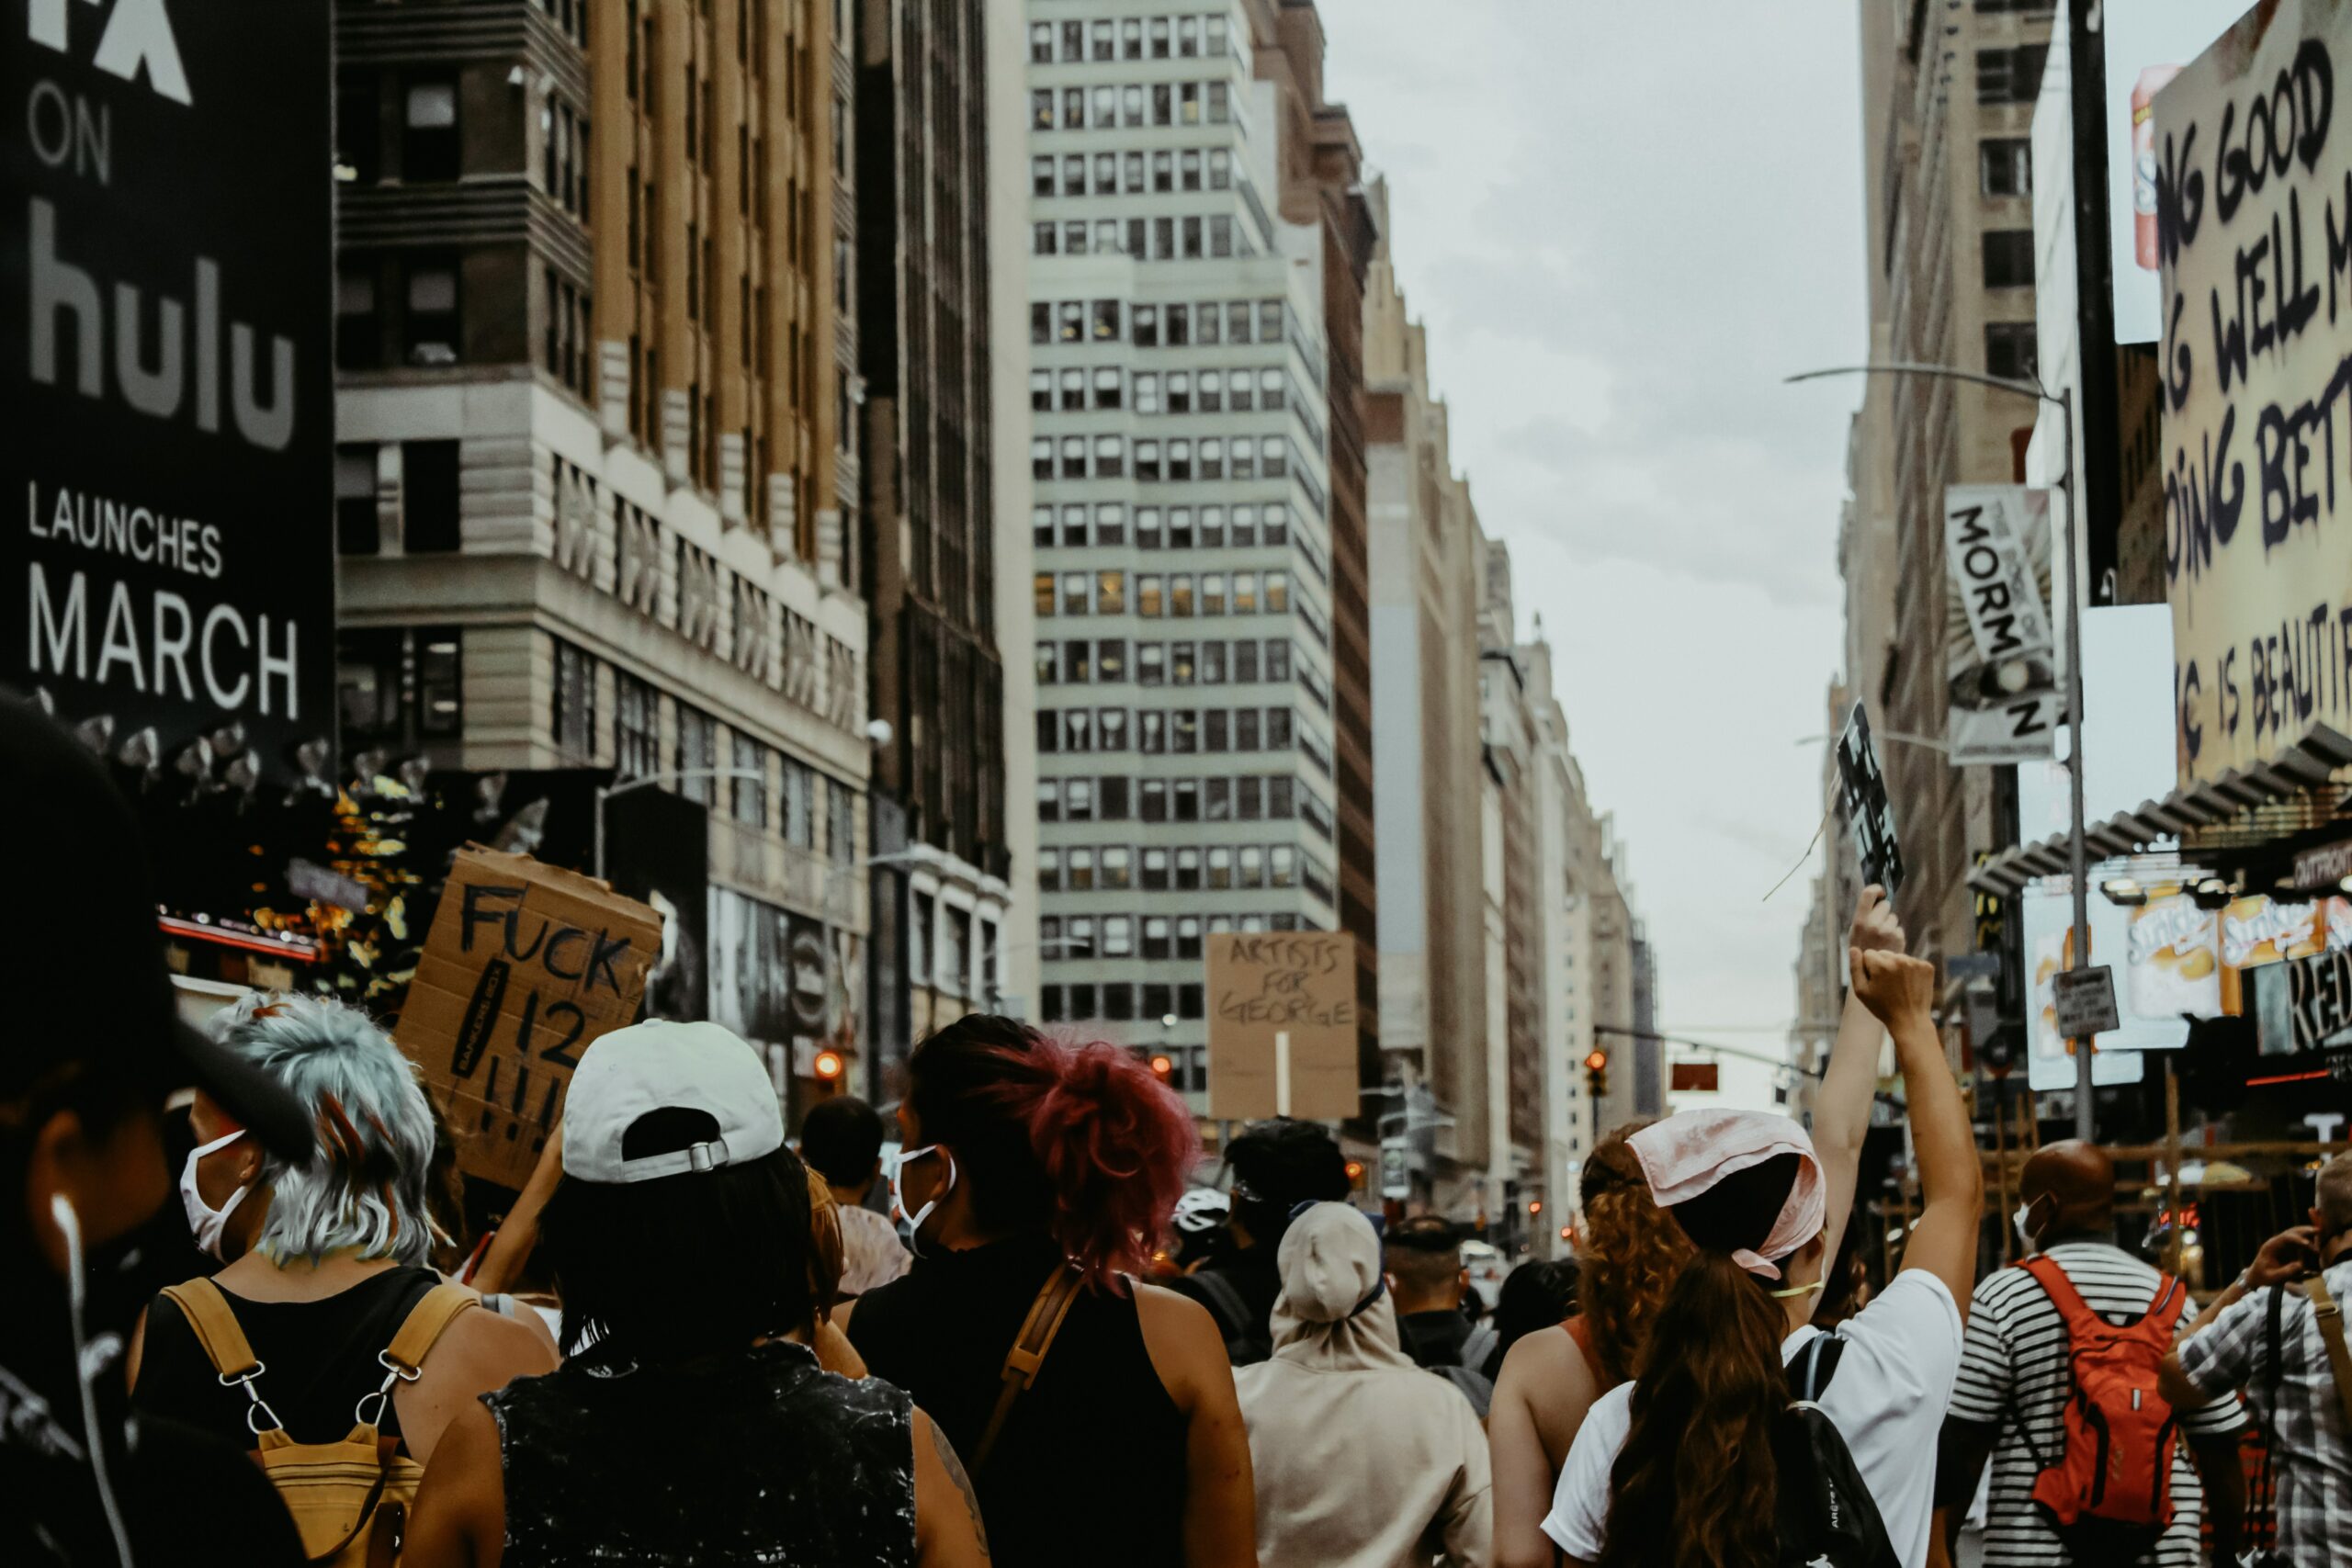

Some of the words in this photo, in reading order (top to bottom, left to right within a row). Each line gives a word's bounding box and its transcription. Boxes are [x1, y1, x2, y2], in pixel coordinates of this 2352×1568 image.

[28, 80, 111, 186] ON
[2215, 38, 2334, 224] GOOD
[28, 195, 295, 451] hulu
[2211, 186, 2320, 395] WELL
[2256, 352, 2352, 553] BET
[28, 480, 222, 579] LAUNCHES
[29, 561, 299, 722] MARCH
[2218, 646, 2240, 737] IS
[461, 882, 631, 999] FUCK
[1230, 938, 1340, 975] ARTISTS
[1262, 968, 1309, 995] FOR
[516, 988, 585, 1072] 12
[1217, 988, 1353, 1027] GEORGE
